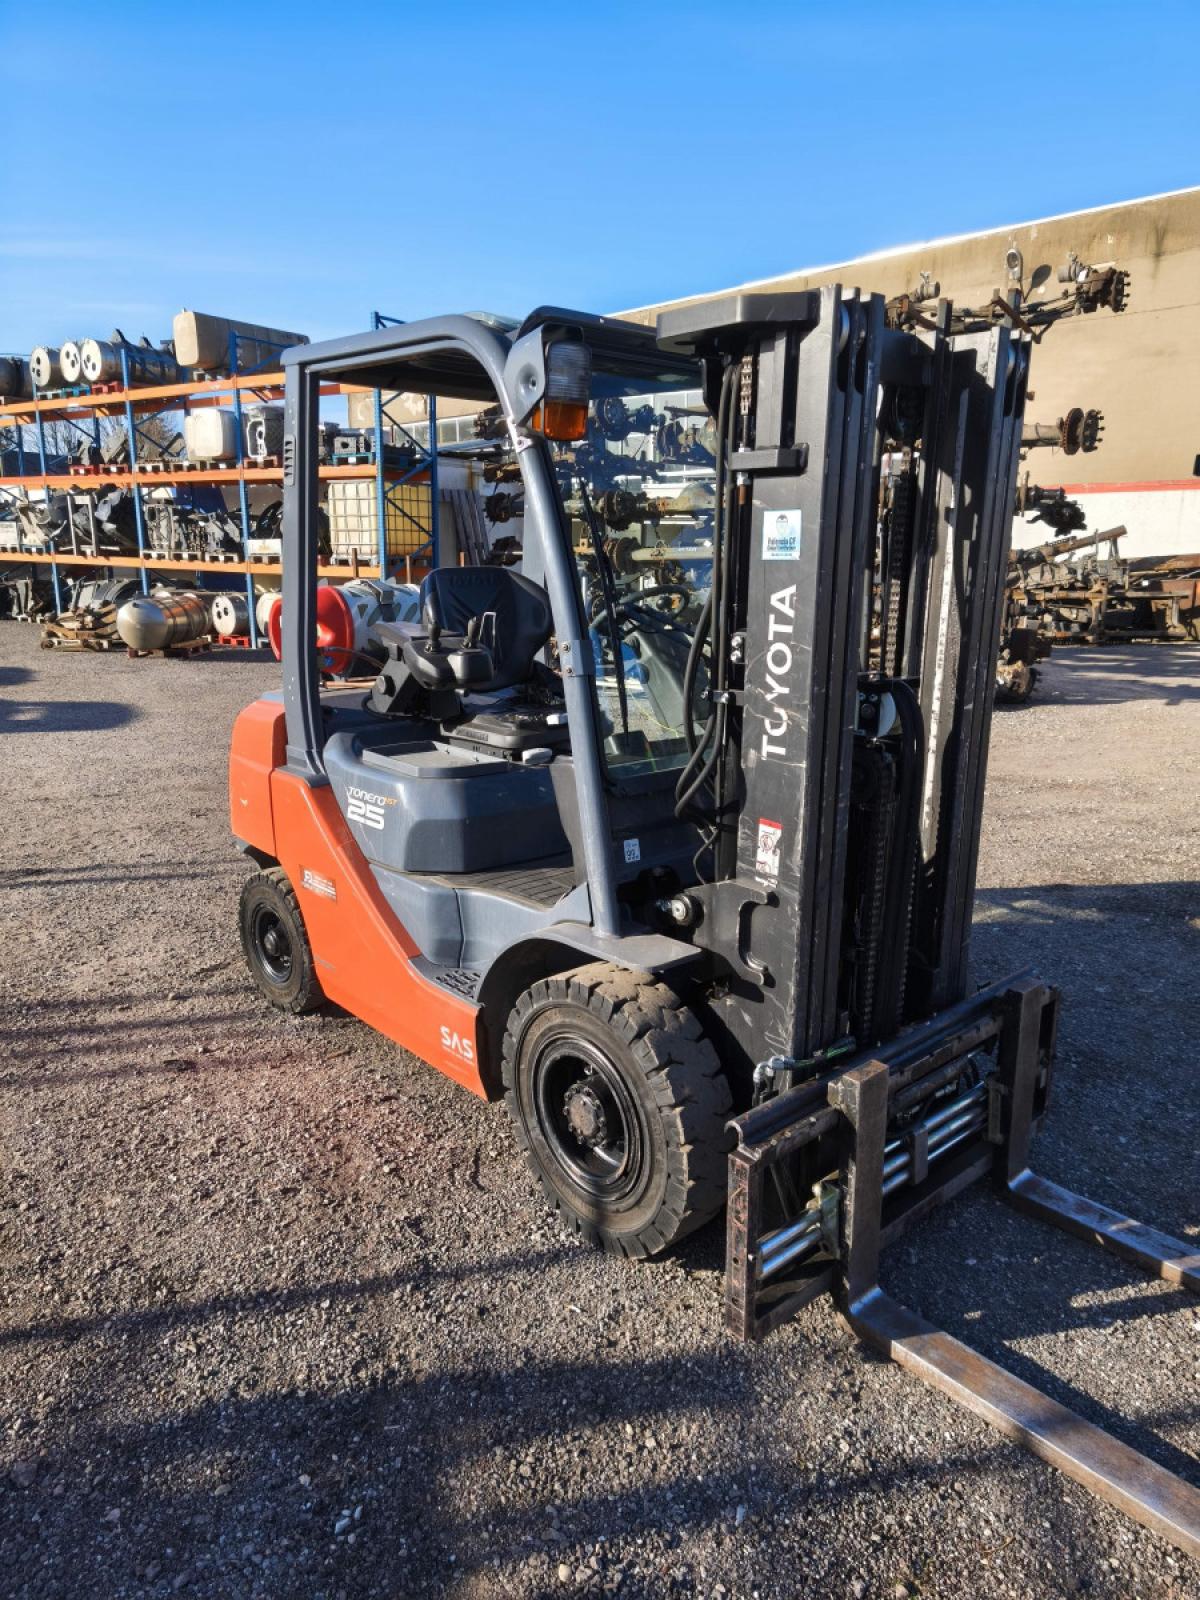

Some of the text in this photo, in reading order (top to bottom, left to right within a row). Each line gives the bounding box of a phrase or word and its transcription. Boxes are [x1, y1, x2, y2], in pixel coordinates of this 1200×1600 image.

[761, 584, 796, 760] TOYOTA
[347, 798, 385, 830] 25
[440, 1025, 474, 1060] SAS
